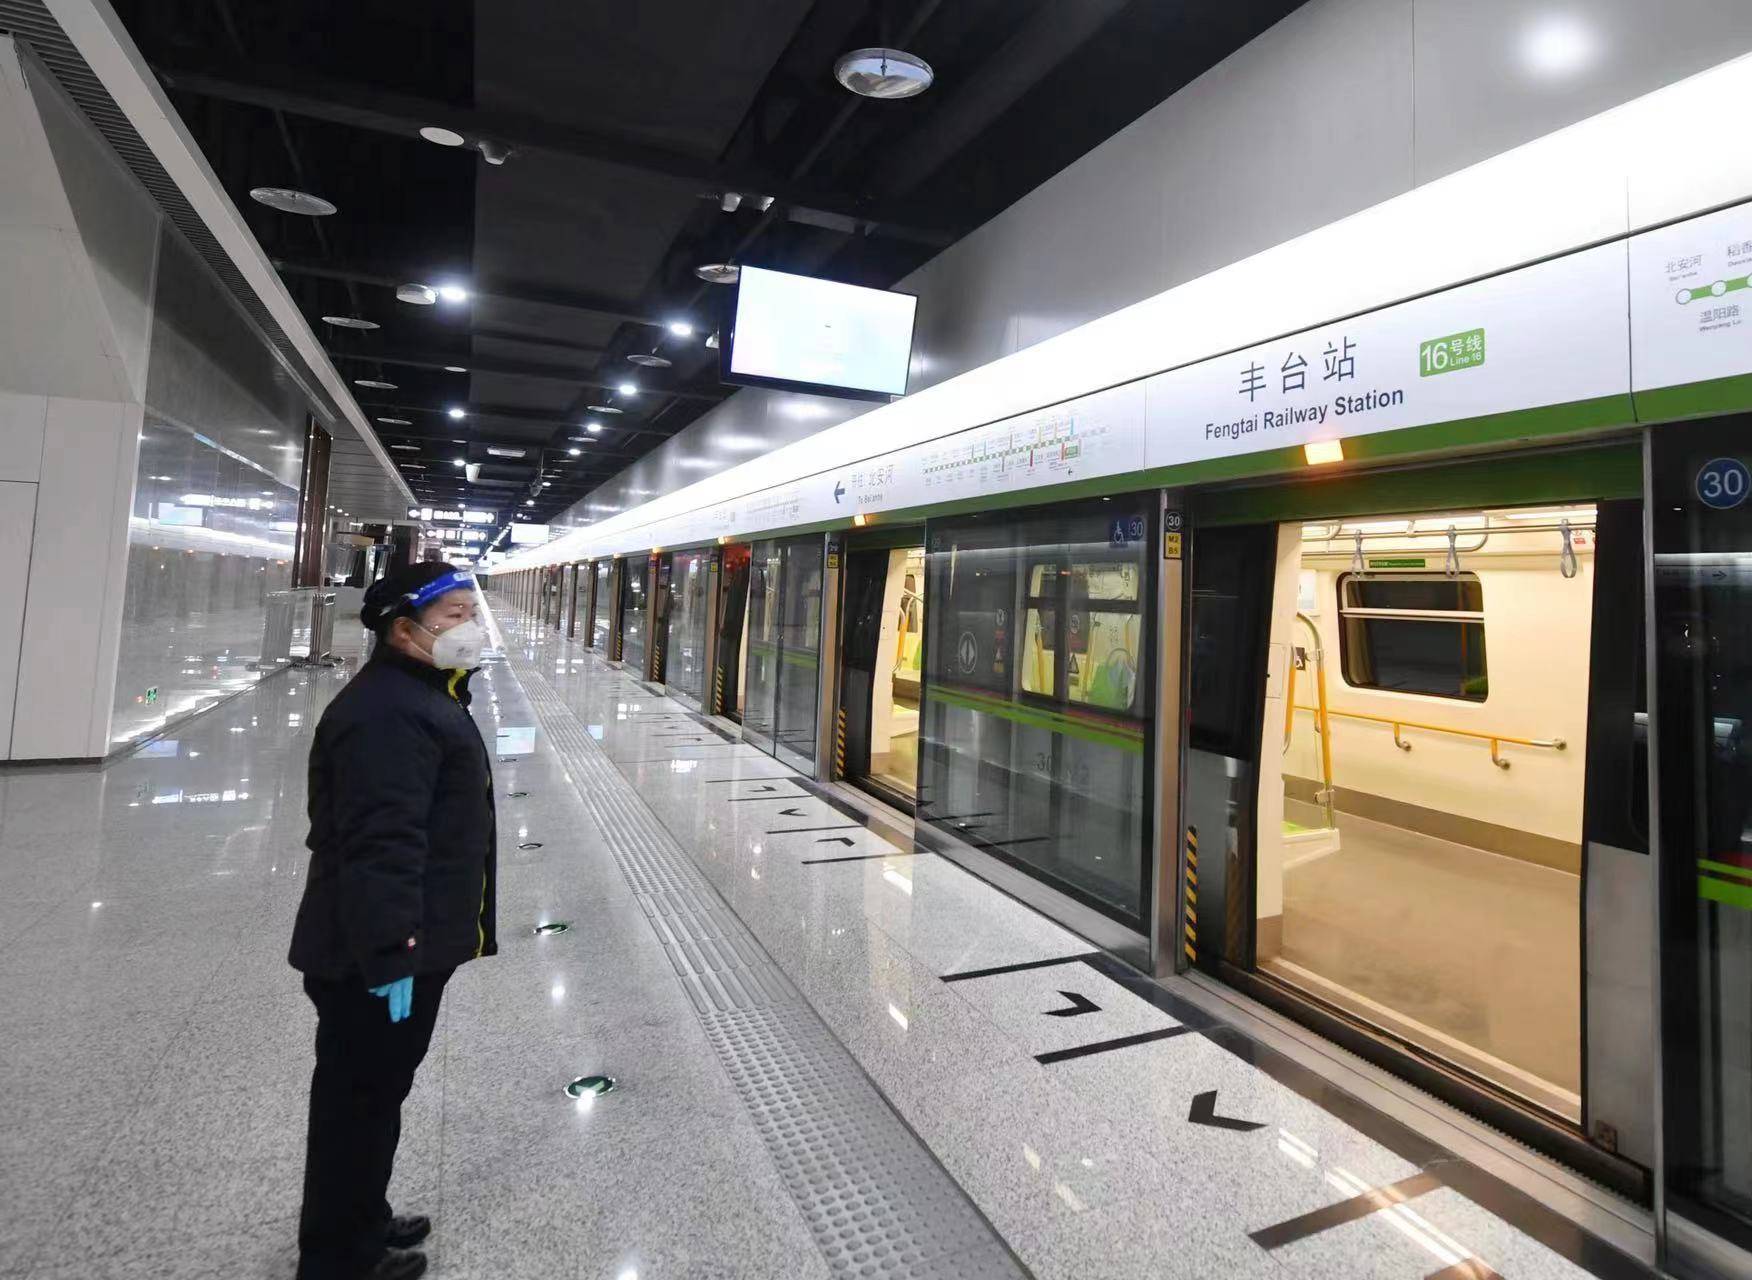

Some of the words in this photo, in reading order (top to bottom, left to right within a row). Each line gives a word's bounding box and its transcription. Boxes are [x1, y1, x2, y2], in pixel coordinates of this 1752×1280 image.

[1239, 336, 1357, 402] 丰台站
[1450, 356, 1470, 367] Line
[1471, 351, 1482, 361] 16
[1205, 414, 1258, 440] Fengtai
[1263, 404, 1328, 430] Railway
[1334, 389, 1404, 416] Station
[1703, 469, 1744, 498] 30
[1130, 521, 1144, 537] 30
[1168, 515, 1181, 527] 30
